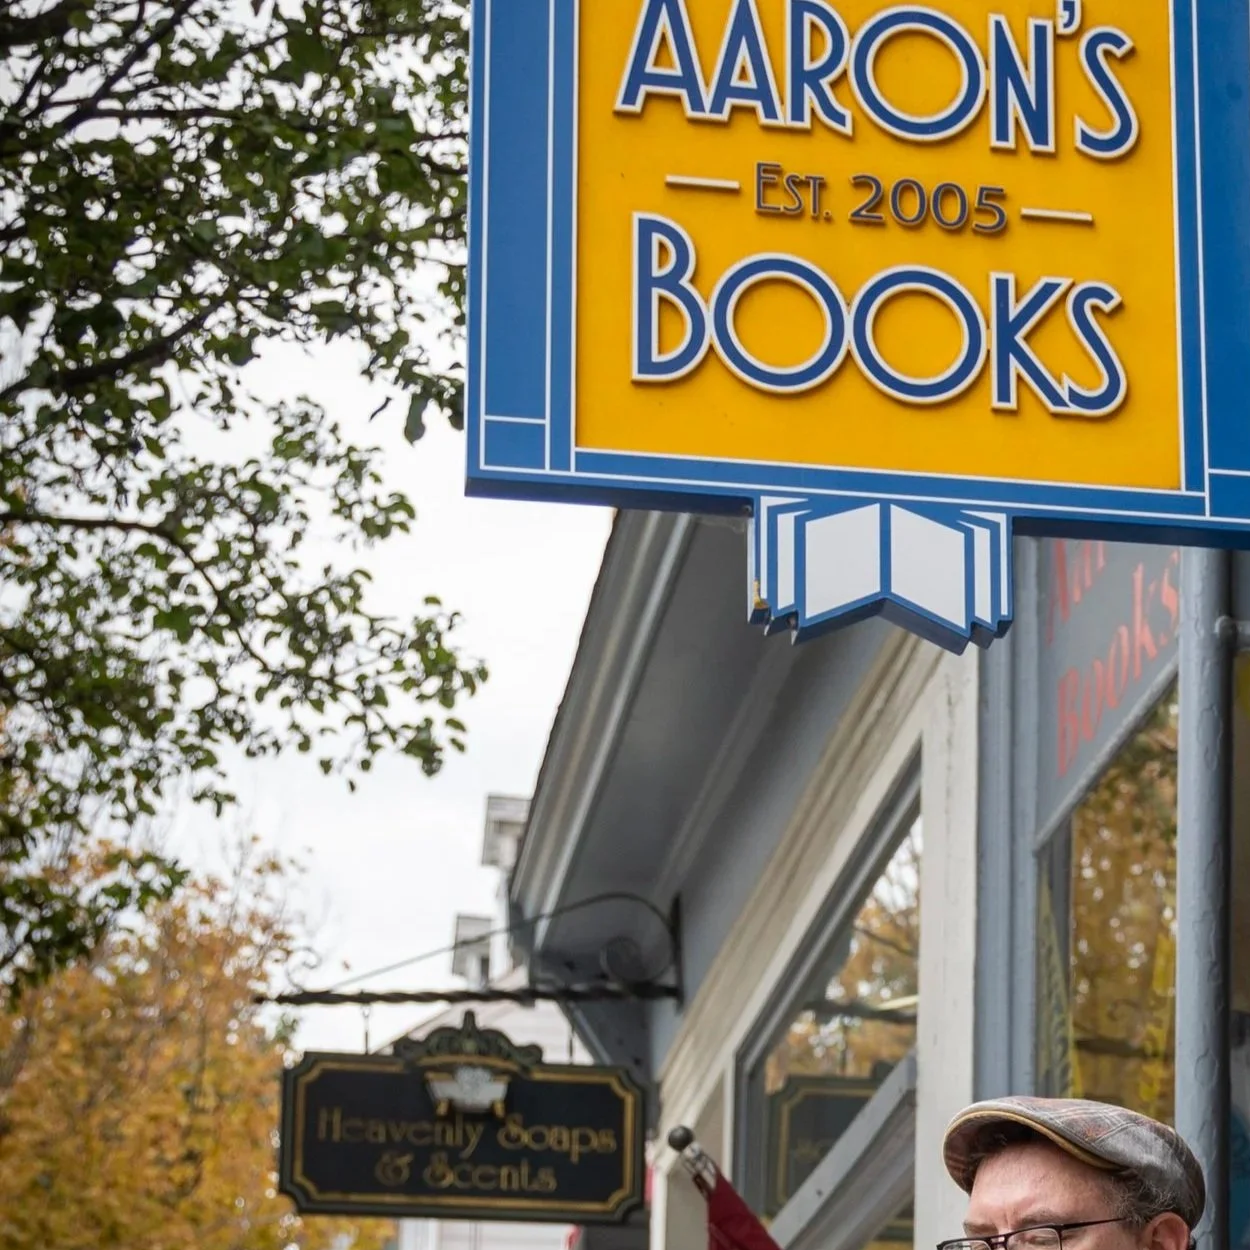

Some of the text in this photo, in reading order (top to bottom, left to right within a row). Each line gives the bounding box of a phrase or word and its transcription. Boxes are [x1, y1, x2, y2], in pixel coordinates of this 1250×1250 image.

[612, 0, 1139, 161] AARON'S
[848, 174, 1008, 232] 2005
[630, 211, 1129, 418] BOOKS
[317, 1107, 617, 1162] Heavenly Soaps
[375, 1154, 558, 1193] & Scents
